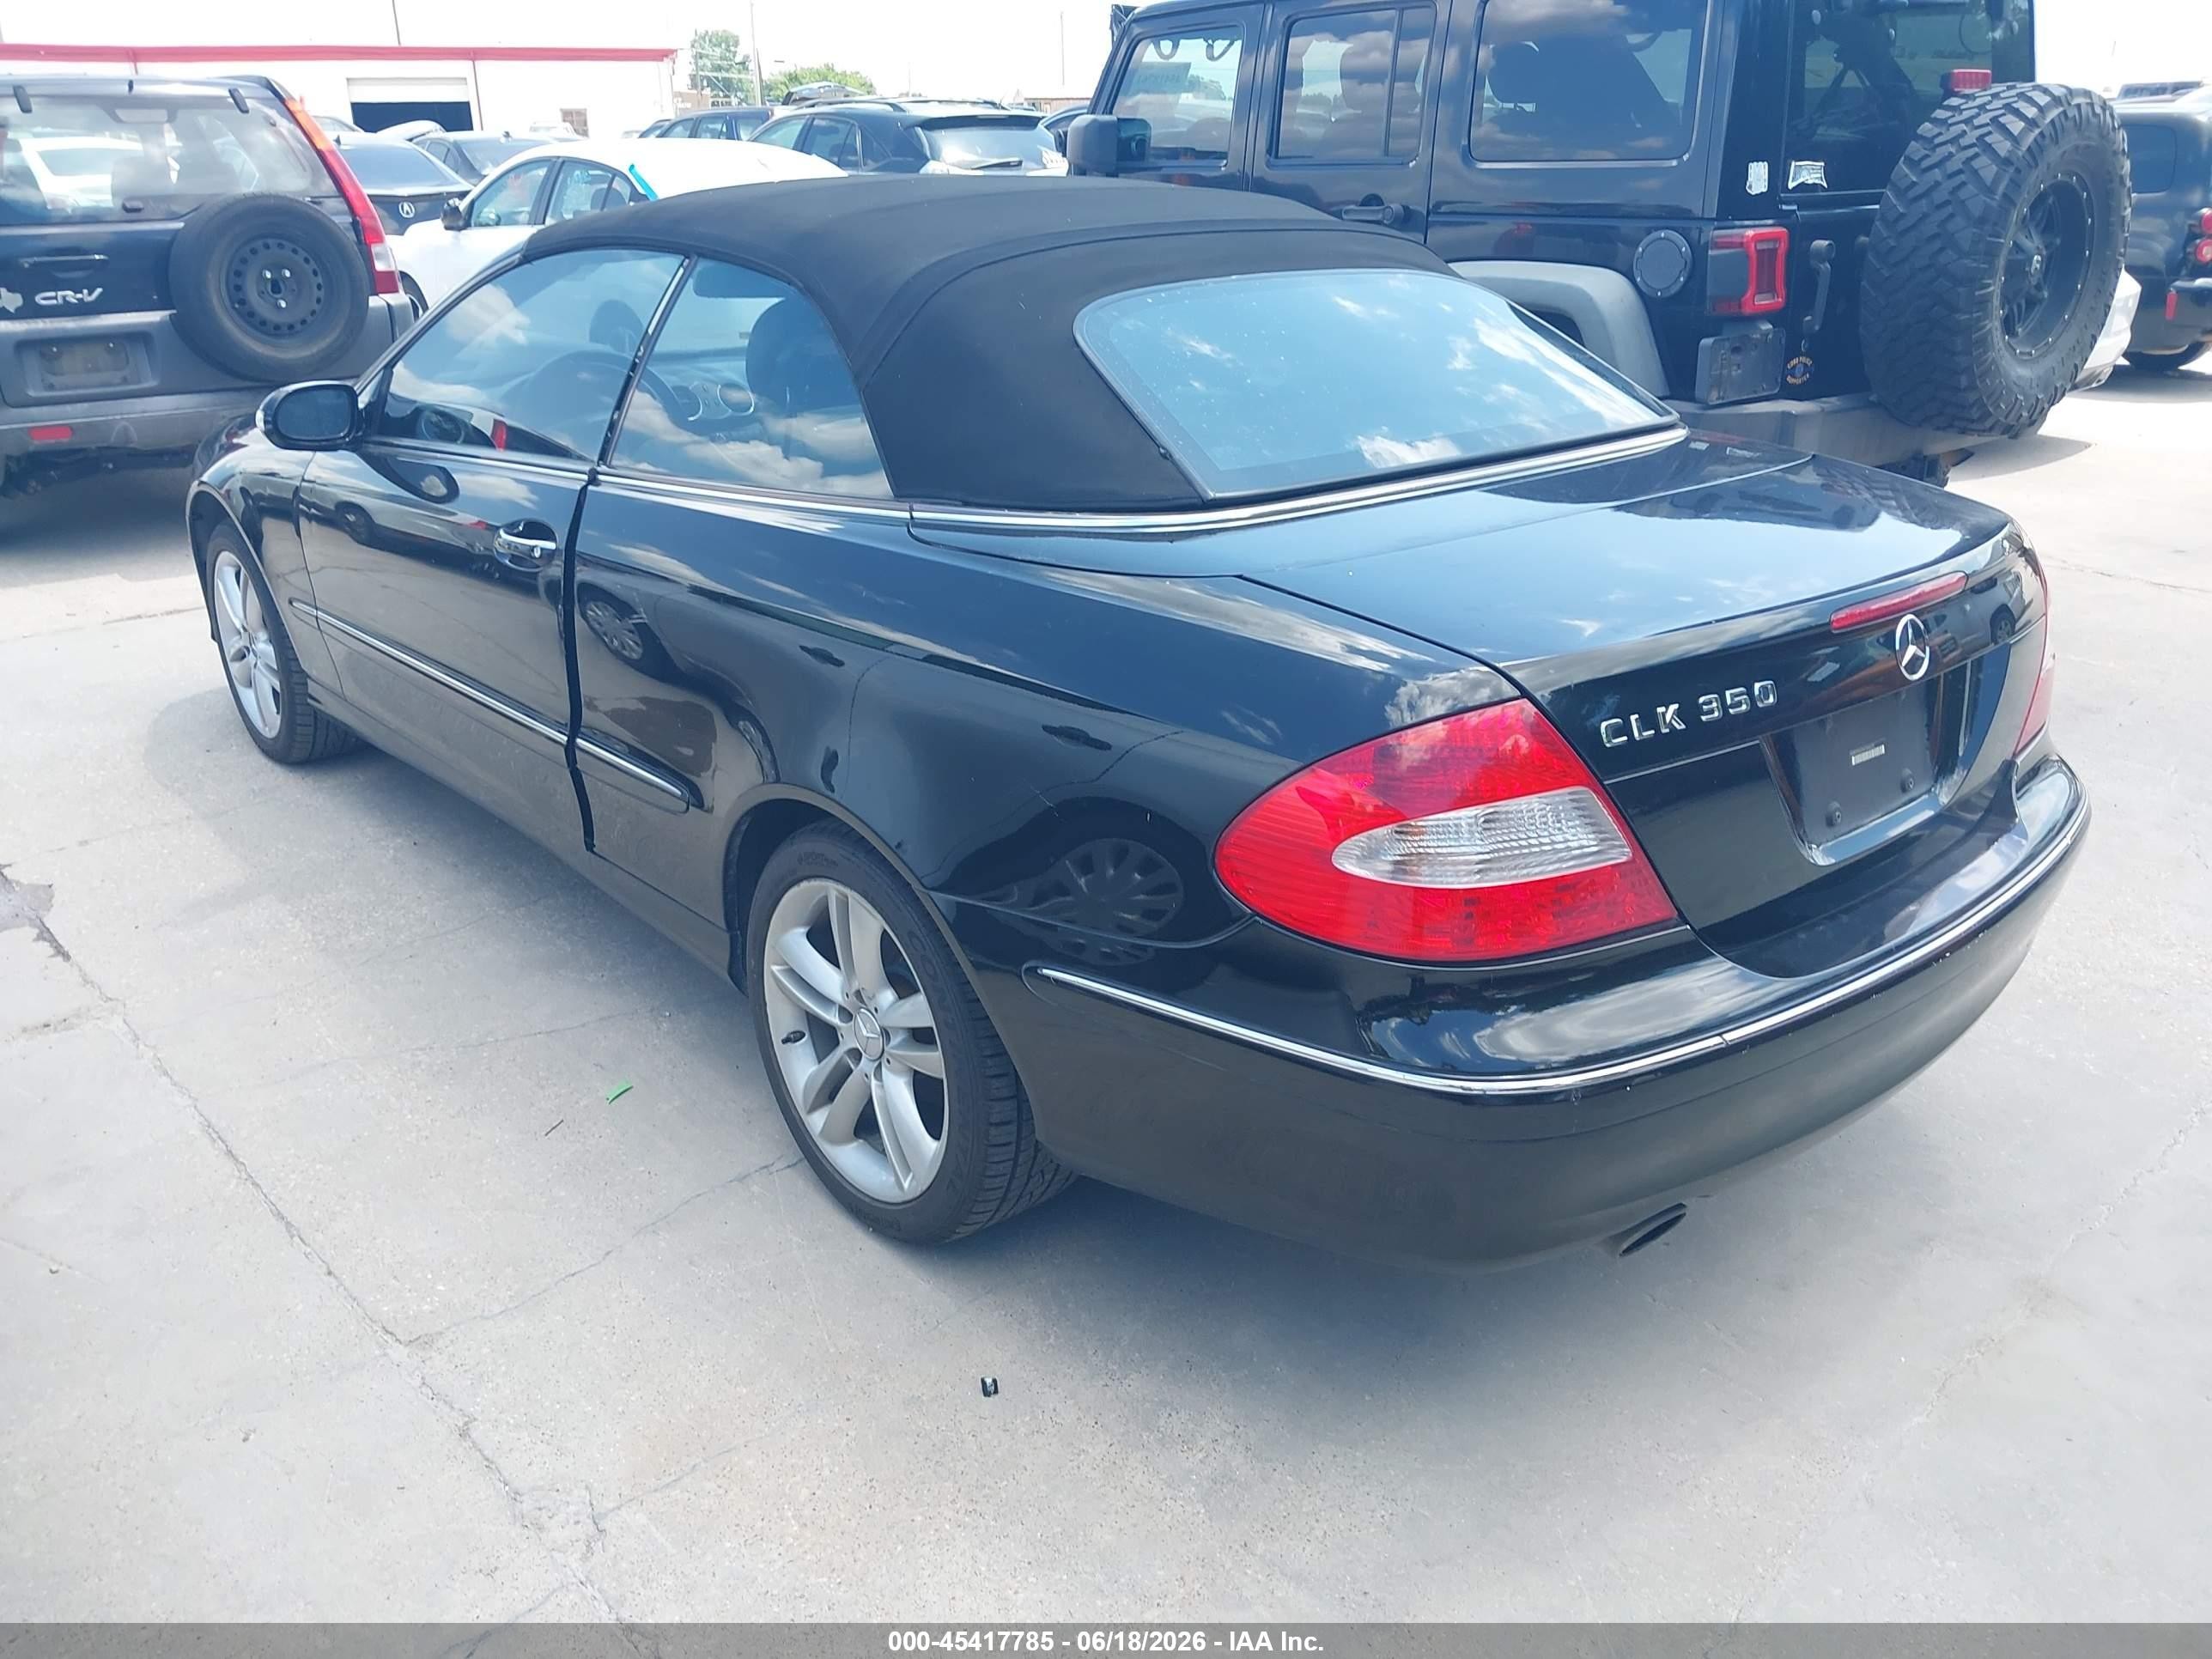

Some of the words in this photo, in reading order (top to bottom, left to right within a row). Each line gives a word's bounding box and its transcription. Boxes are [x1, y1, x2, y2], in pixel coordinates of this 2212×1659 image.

[35, 288, 103, 305] CR-V
[1601, 703, 1686, 748] CLK
[1698, 680, 1778, 722] 350
